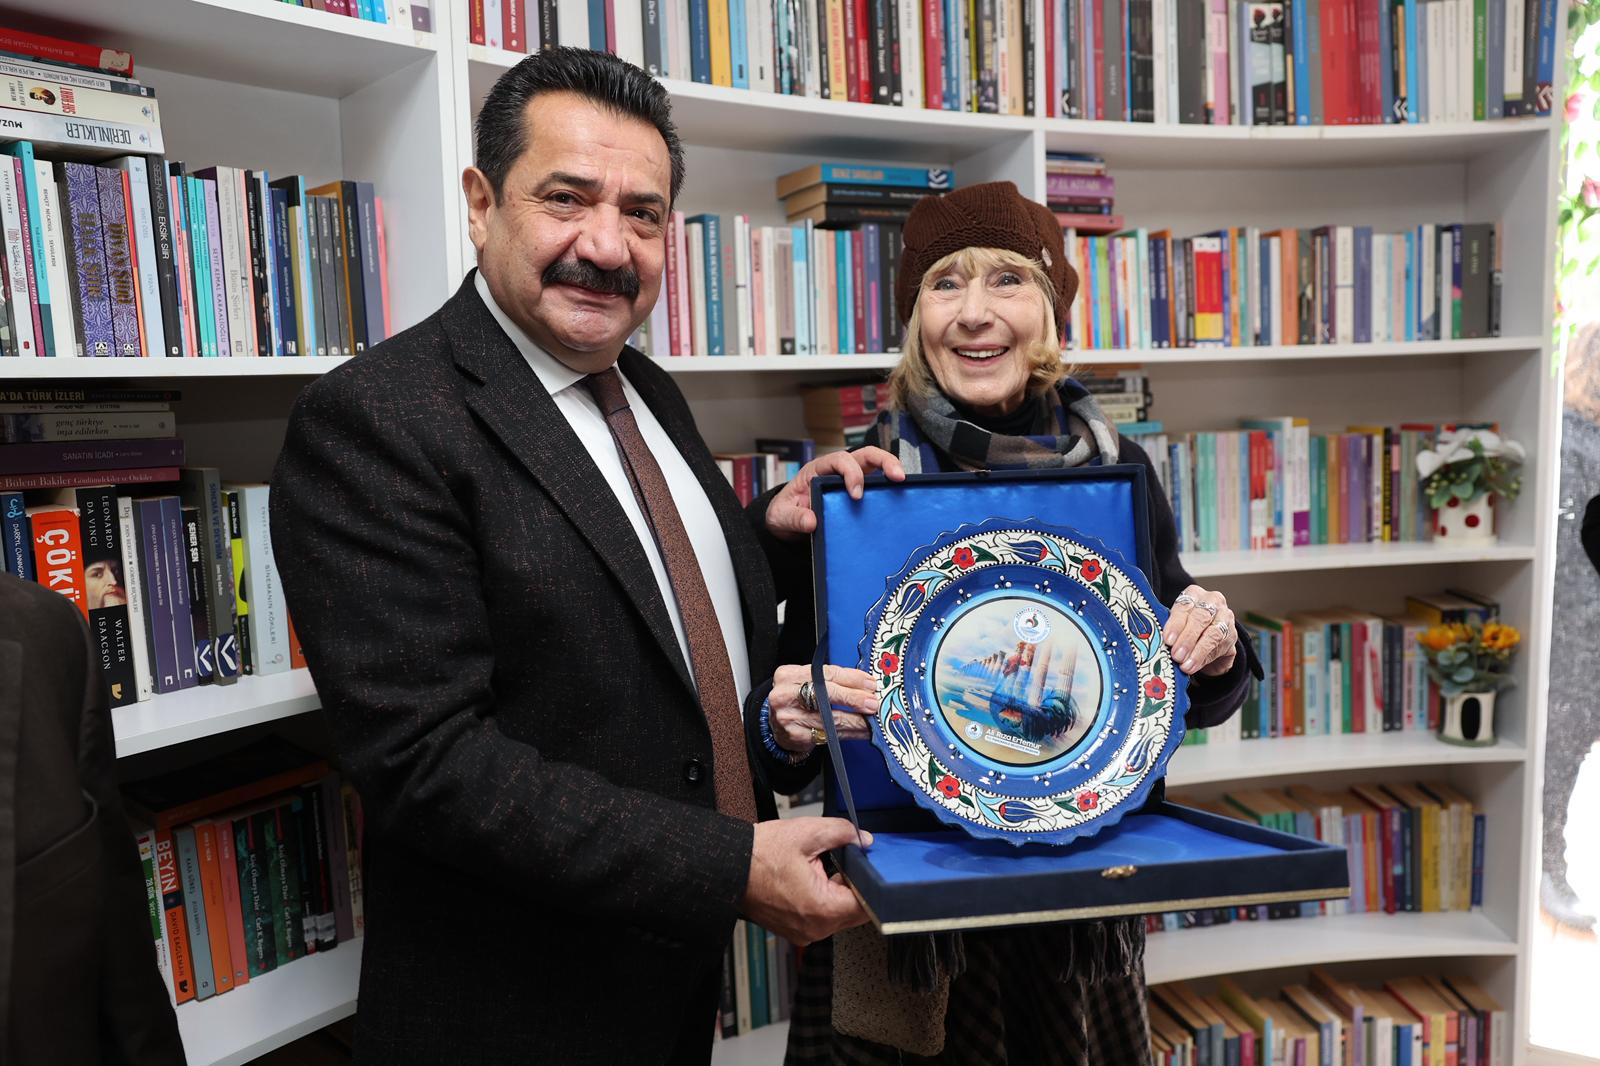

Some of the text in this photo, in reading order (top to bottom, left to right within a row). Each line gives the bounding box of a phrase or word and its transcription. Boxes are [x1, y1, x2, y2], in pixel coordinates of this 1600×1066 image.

[65, 121, 131, 145] DERİNLİKLER
[152, 163, 163, 190] SEZEN
[5, 193, 13, 214] FİKRET
[43, 188, 51, 207] BEHÇET
[155, 191, 165, 214] AKSU
[79, 213, 97, 256] HALK
[158, 216, 168, 241] EKSİK
[107, 222, 127, 267] DİVAN
[211, 248, 219, 266] SEYİT
[26, 389, 53, 401] TÜRK
[54, 388, 85, 401] İZLERİ
[56, 418, 73, 428] genç
[75, 417, 104, 429] türkiye
[62, 449, 114, 461] SANATIN İCADI
[5, 477, 36, 488] Bülent
[39, 474, 72, 486] Bakiler
[13, 523, 21, 547] DARRYL
[86, 500, 98, 547] DA VINCI
[101, 495, 113, 550] LEONARDO
[187, 522, 199, 547] ŞENER
[14, 547, 25, 580] CUNNINGHA
[36, 528, 81, 603] ÇÖKÜ
[189, 548, 201, 563] ŞEN
[264, 564, 278, 645] SİNEMANIN KÖKLERİ
[98, 616, 111, 671] ISAACSON
[114, 618, 126, 663] WALTER
[1012, 735, 1042, 751] Ertemur
[156, 840, 178, 893] BEYİN
[169, 911, 185, 977] DAVID EAGLEMAN
